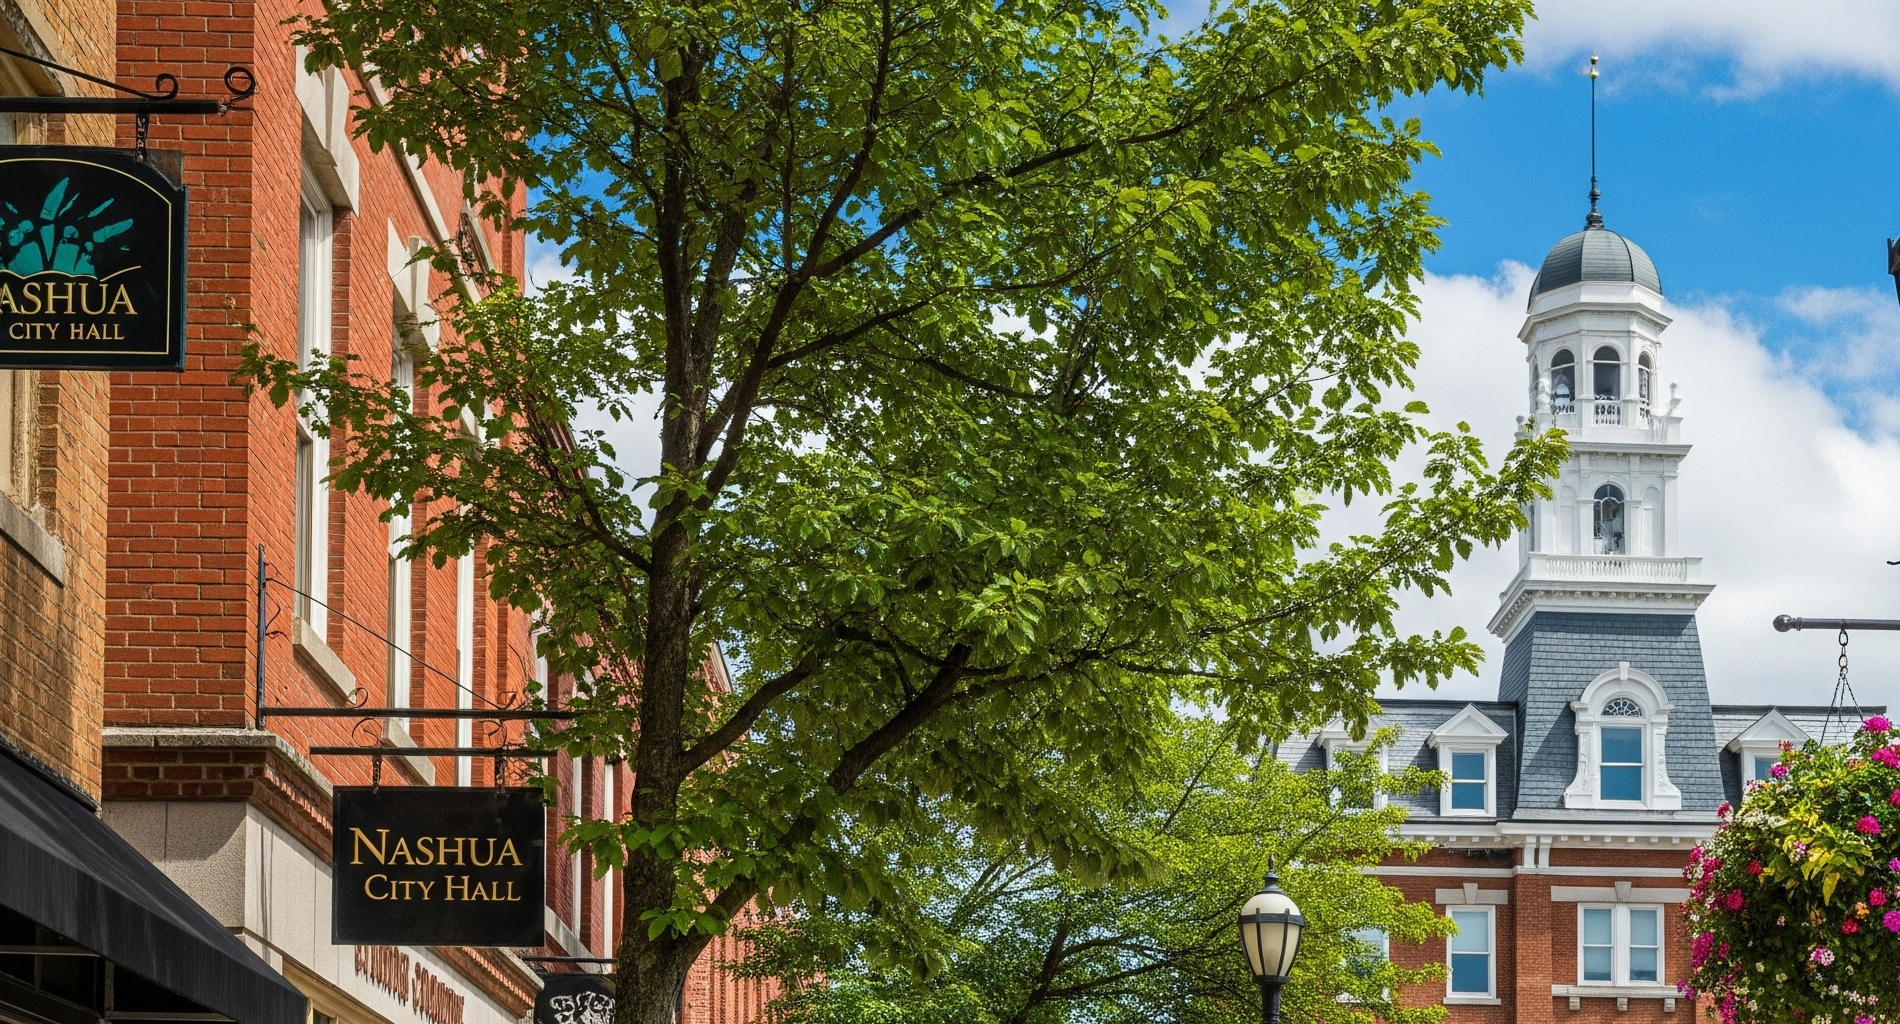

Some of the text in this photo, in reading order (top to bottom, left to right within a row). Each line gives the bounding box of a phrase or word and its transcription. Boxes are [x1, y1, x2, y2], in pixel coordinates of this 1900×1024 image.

[9, 322, 125, 340] CITY HALL
[349, 827, 524, 867] NASHUA
[364, 874, 521, 901] CITY HALL
